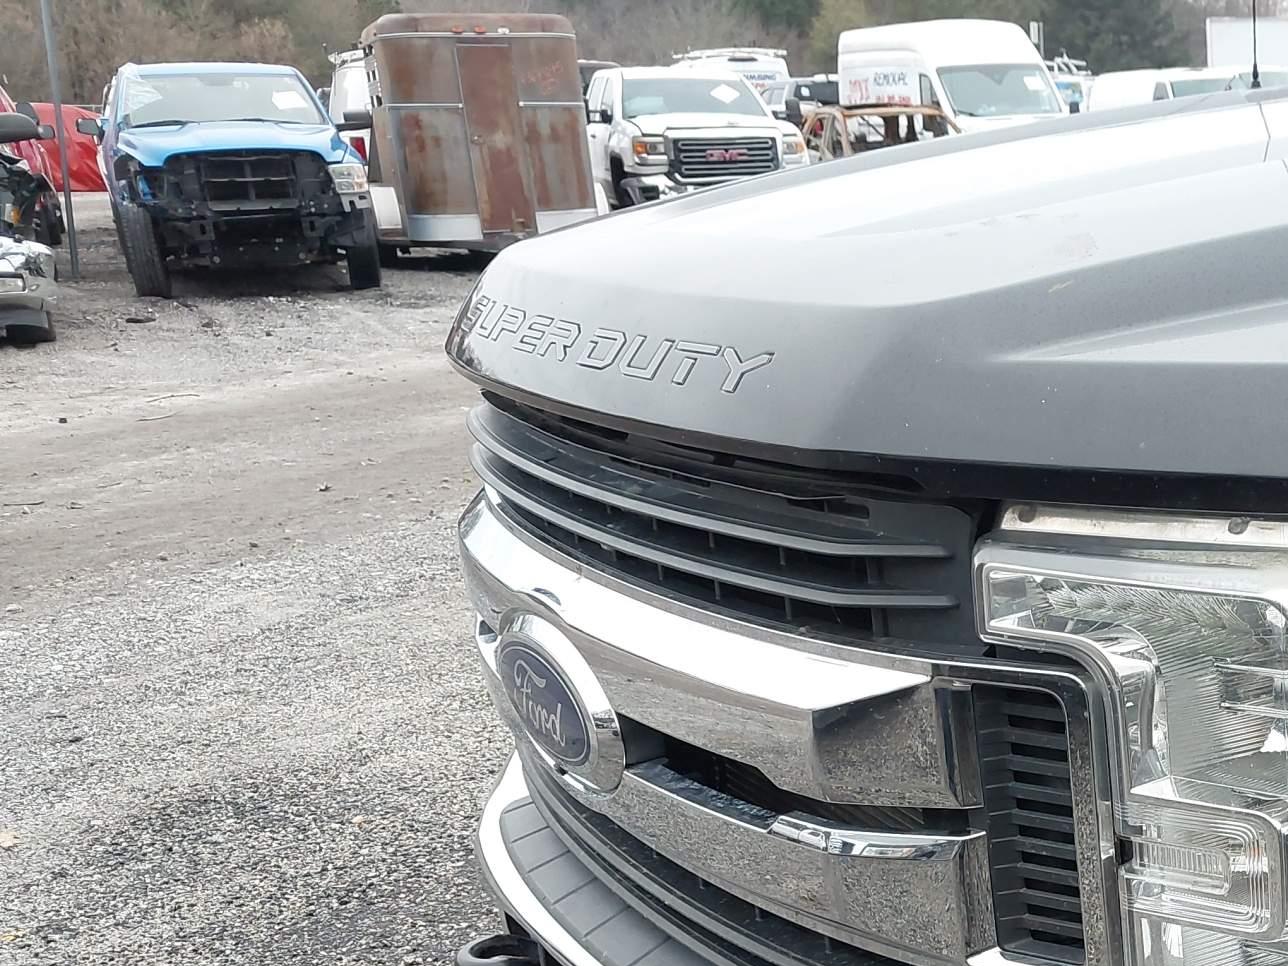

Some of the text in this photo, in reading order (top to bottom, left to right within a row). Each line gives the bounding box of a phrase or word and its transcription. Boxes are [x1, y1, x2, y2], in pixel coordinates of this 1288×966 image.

[705, 148, 750, 161] GMC
[575, 327, 775, 394] DUTY
[513, 658, 567, 747] Ford
